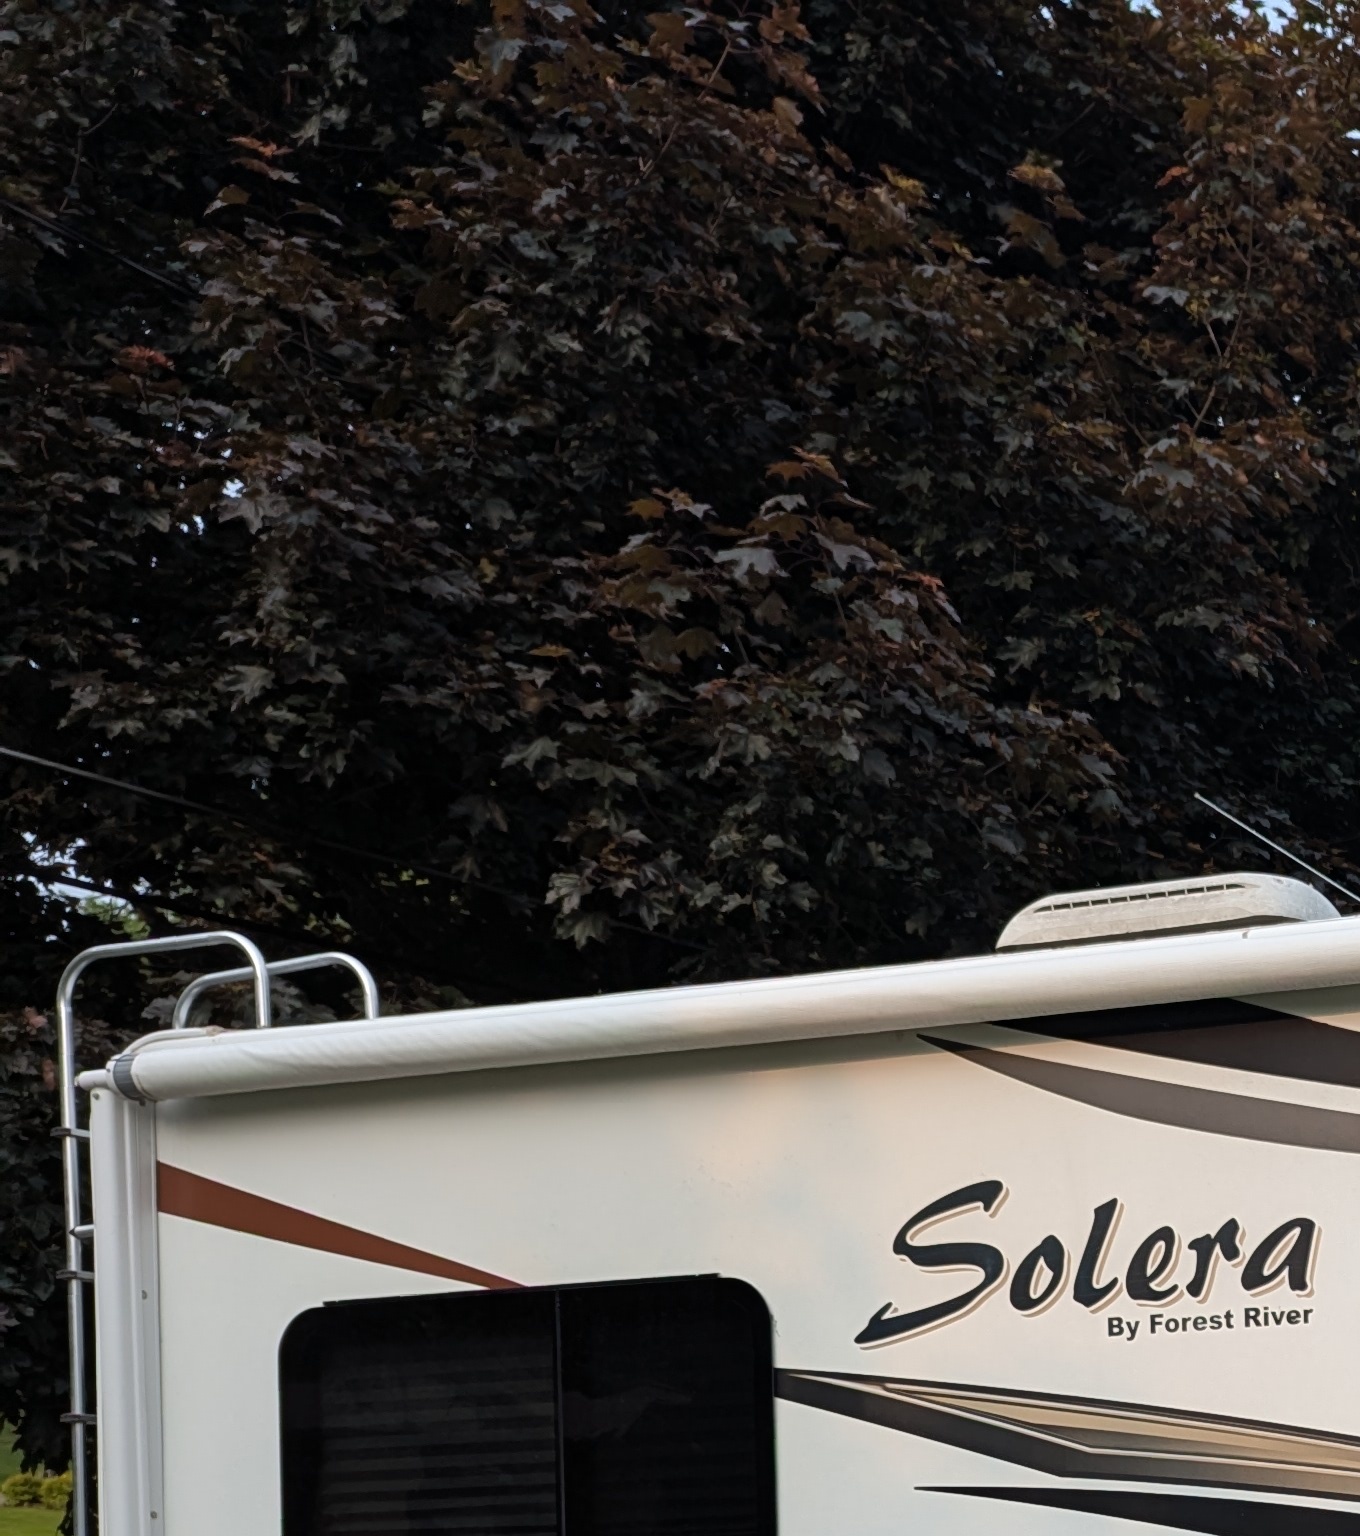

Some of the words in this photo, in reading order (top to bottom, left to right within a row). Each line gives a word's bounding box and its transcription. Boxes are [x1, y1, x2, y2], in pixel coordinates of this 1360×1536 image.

[854, 1179, 1322, 1349] Solera
[1107, 1315, 1139, 1341] By
[1149, 1309, 1235, 1334] Forest
[1244, 1305, 1314, 1328] River
